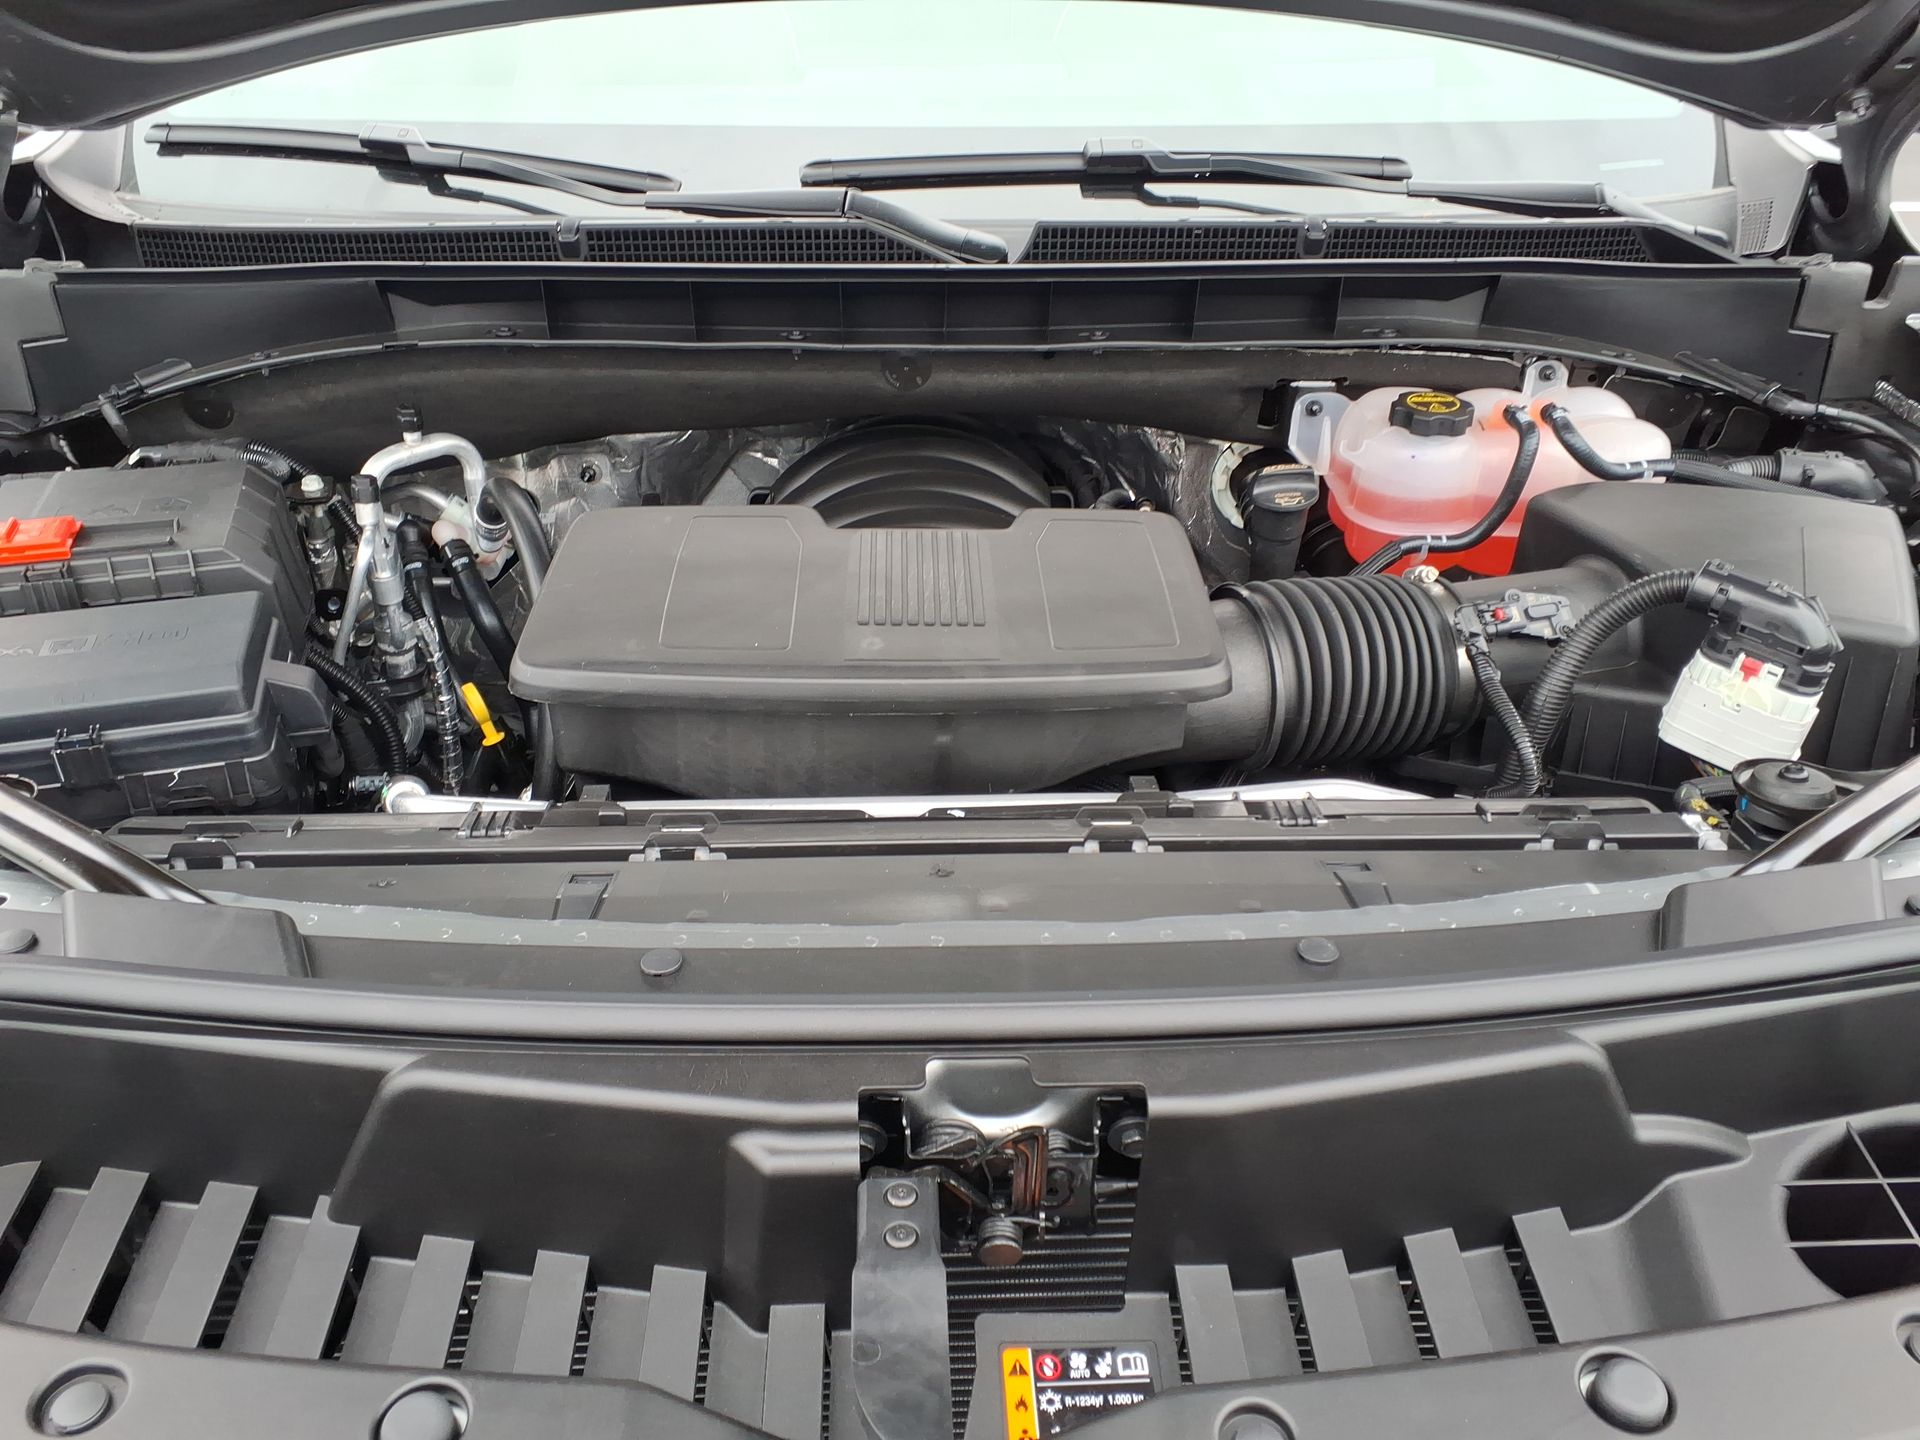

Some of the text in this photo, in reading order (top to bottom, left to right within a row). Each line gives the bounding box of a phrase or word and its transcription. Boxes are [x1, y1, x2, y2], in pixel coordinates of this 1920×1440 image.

[1263, 463, 1308, 473] ACDelco
[1070, 1369, 1090, 1379] AUTO
[1065, 1394, 1103, 1407] R-1234yf
[1107, 1394, 1132, 1405] 1.000
